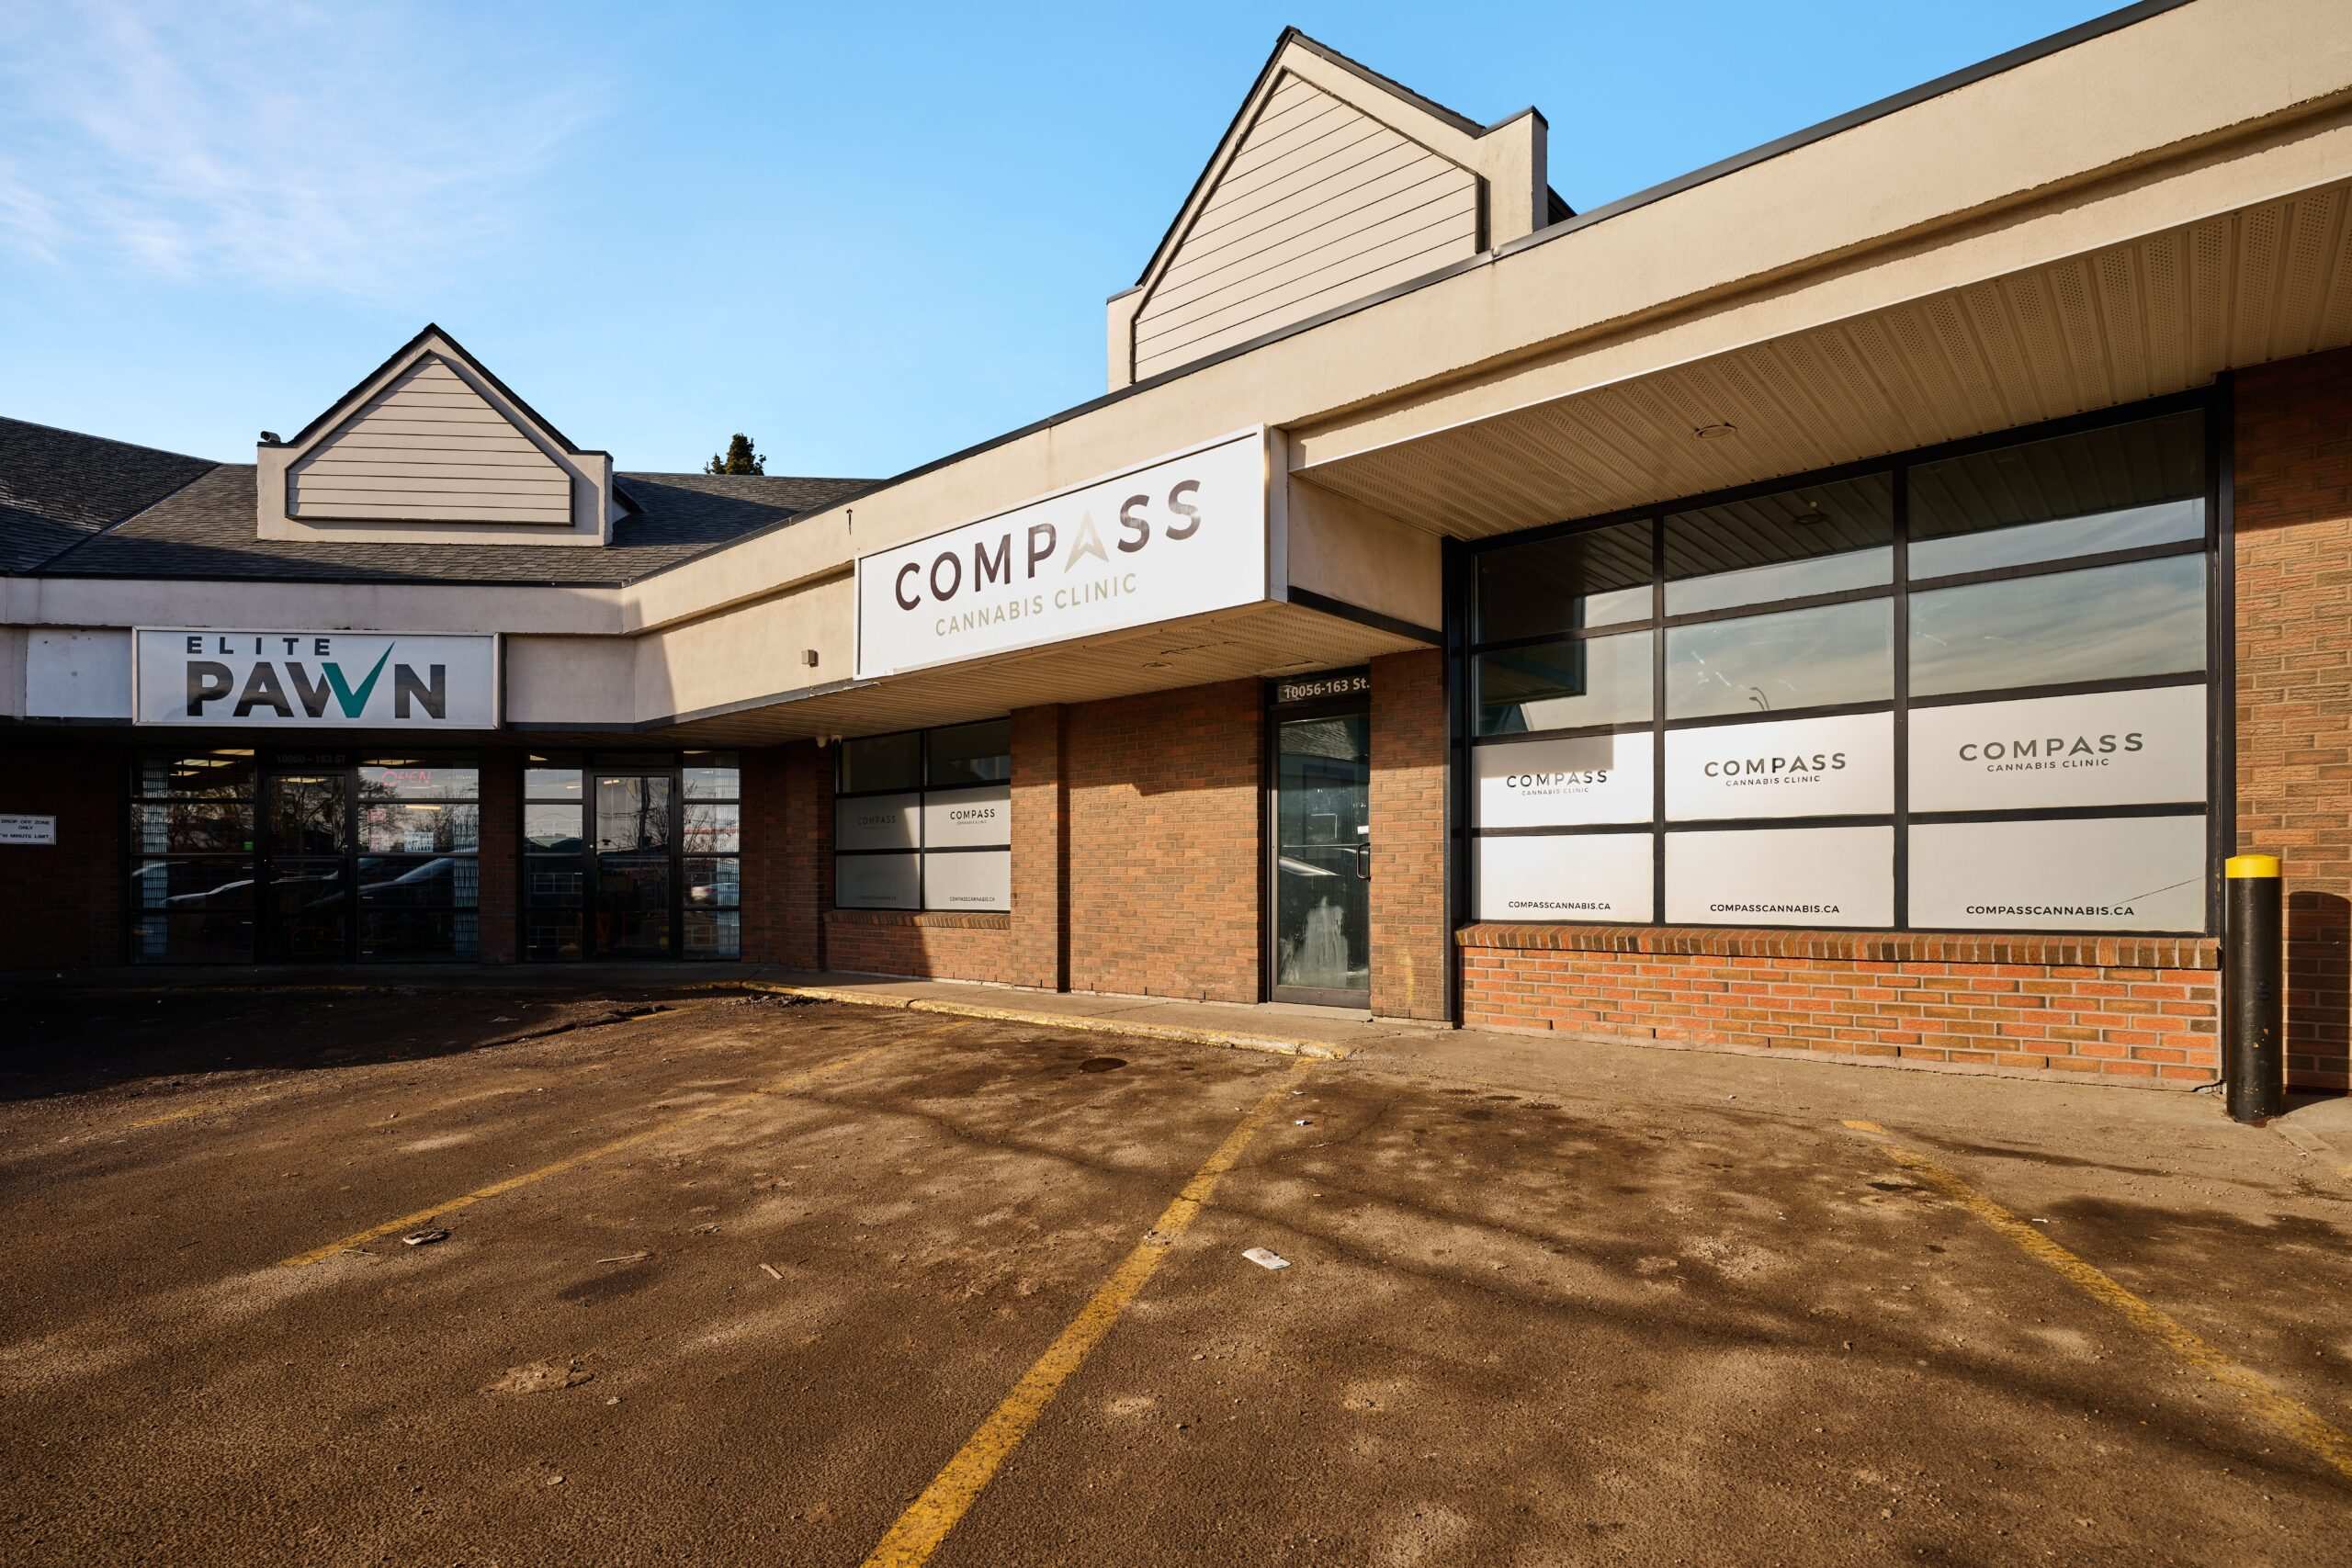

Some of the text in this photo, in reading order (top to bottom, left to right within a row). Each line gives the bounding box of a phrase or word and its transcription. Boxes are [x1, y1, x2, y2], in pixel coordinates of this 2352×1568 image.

[894, 479, 1203, 612] COMPASS
[935, 573, 1137, 637] CANNABIS CLINIC
[187, 636, 331, 657] ELITE
[187, 641, 447, 719] PAWN
[1283, 677, 1371, 699] 10056-163 St.
[1959, 732, 2144, 761] COMPASS
[1704, 752, 1847, 777] COMPASS
[1987, 758, 2110, 773] CANNABIS CLINIC
[1506, 770, 1608, 788] COMPASS
[1725, 775, 1821, 787] CANNABIS CLINIC
[857, 815, 897, 826] COMPASS
[949, 808, 995, 820] COMPASS
[1508, 901, 1611, 910] COMPASSCANNABIS.CA
[1710, 904, 1840, 914] COMPASSCANNABIS.CA
[1966, 906, 2134, 917] COMPASSCANNABIS.CA
